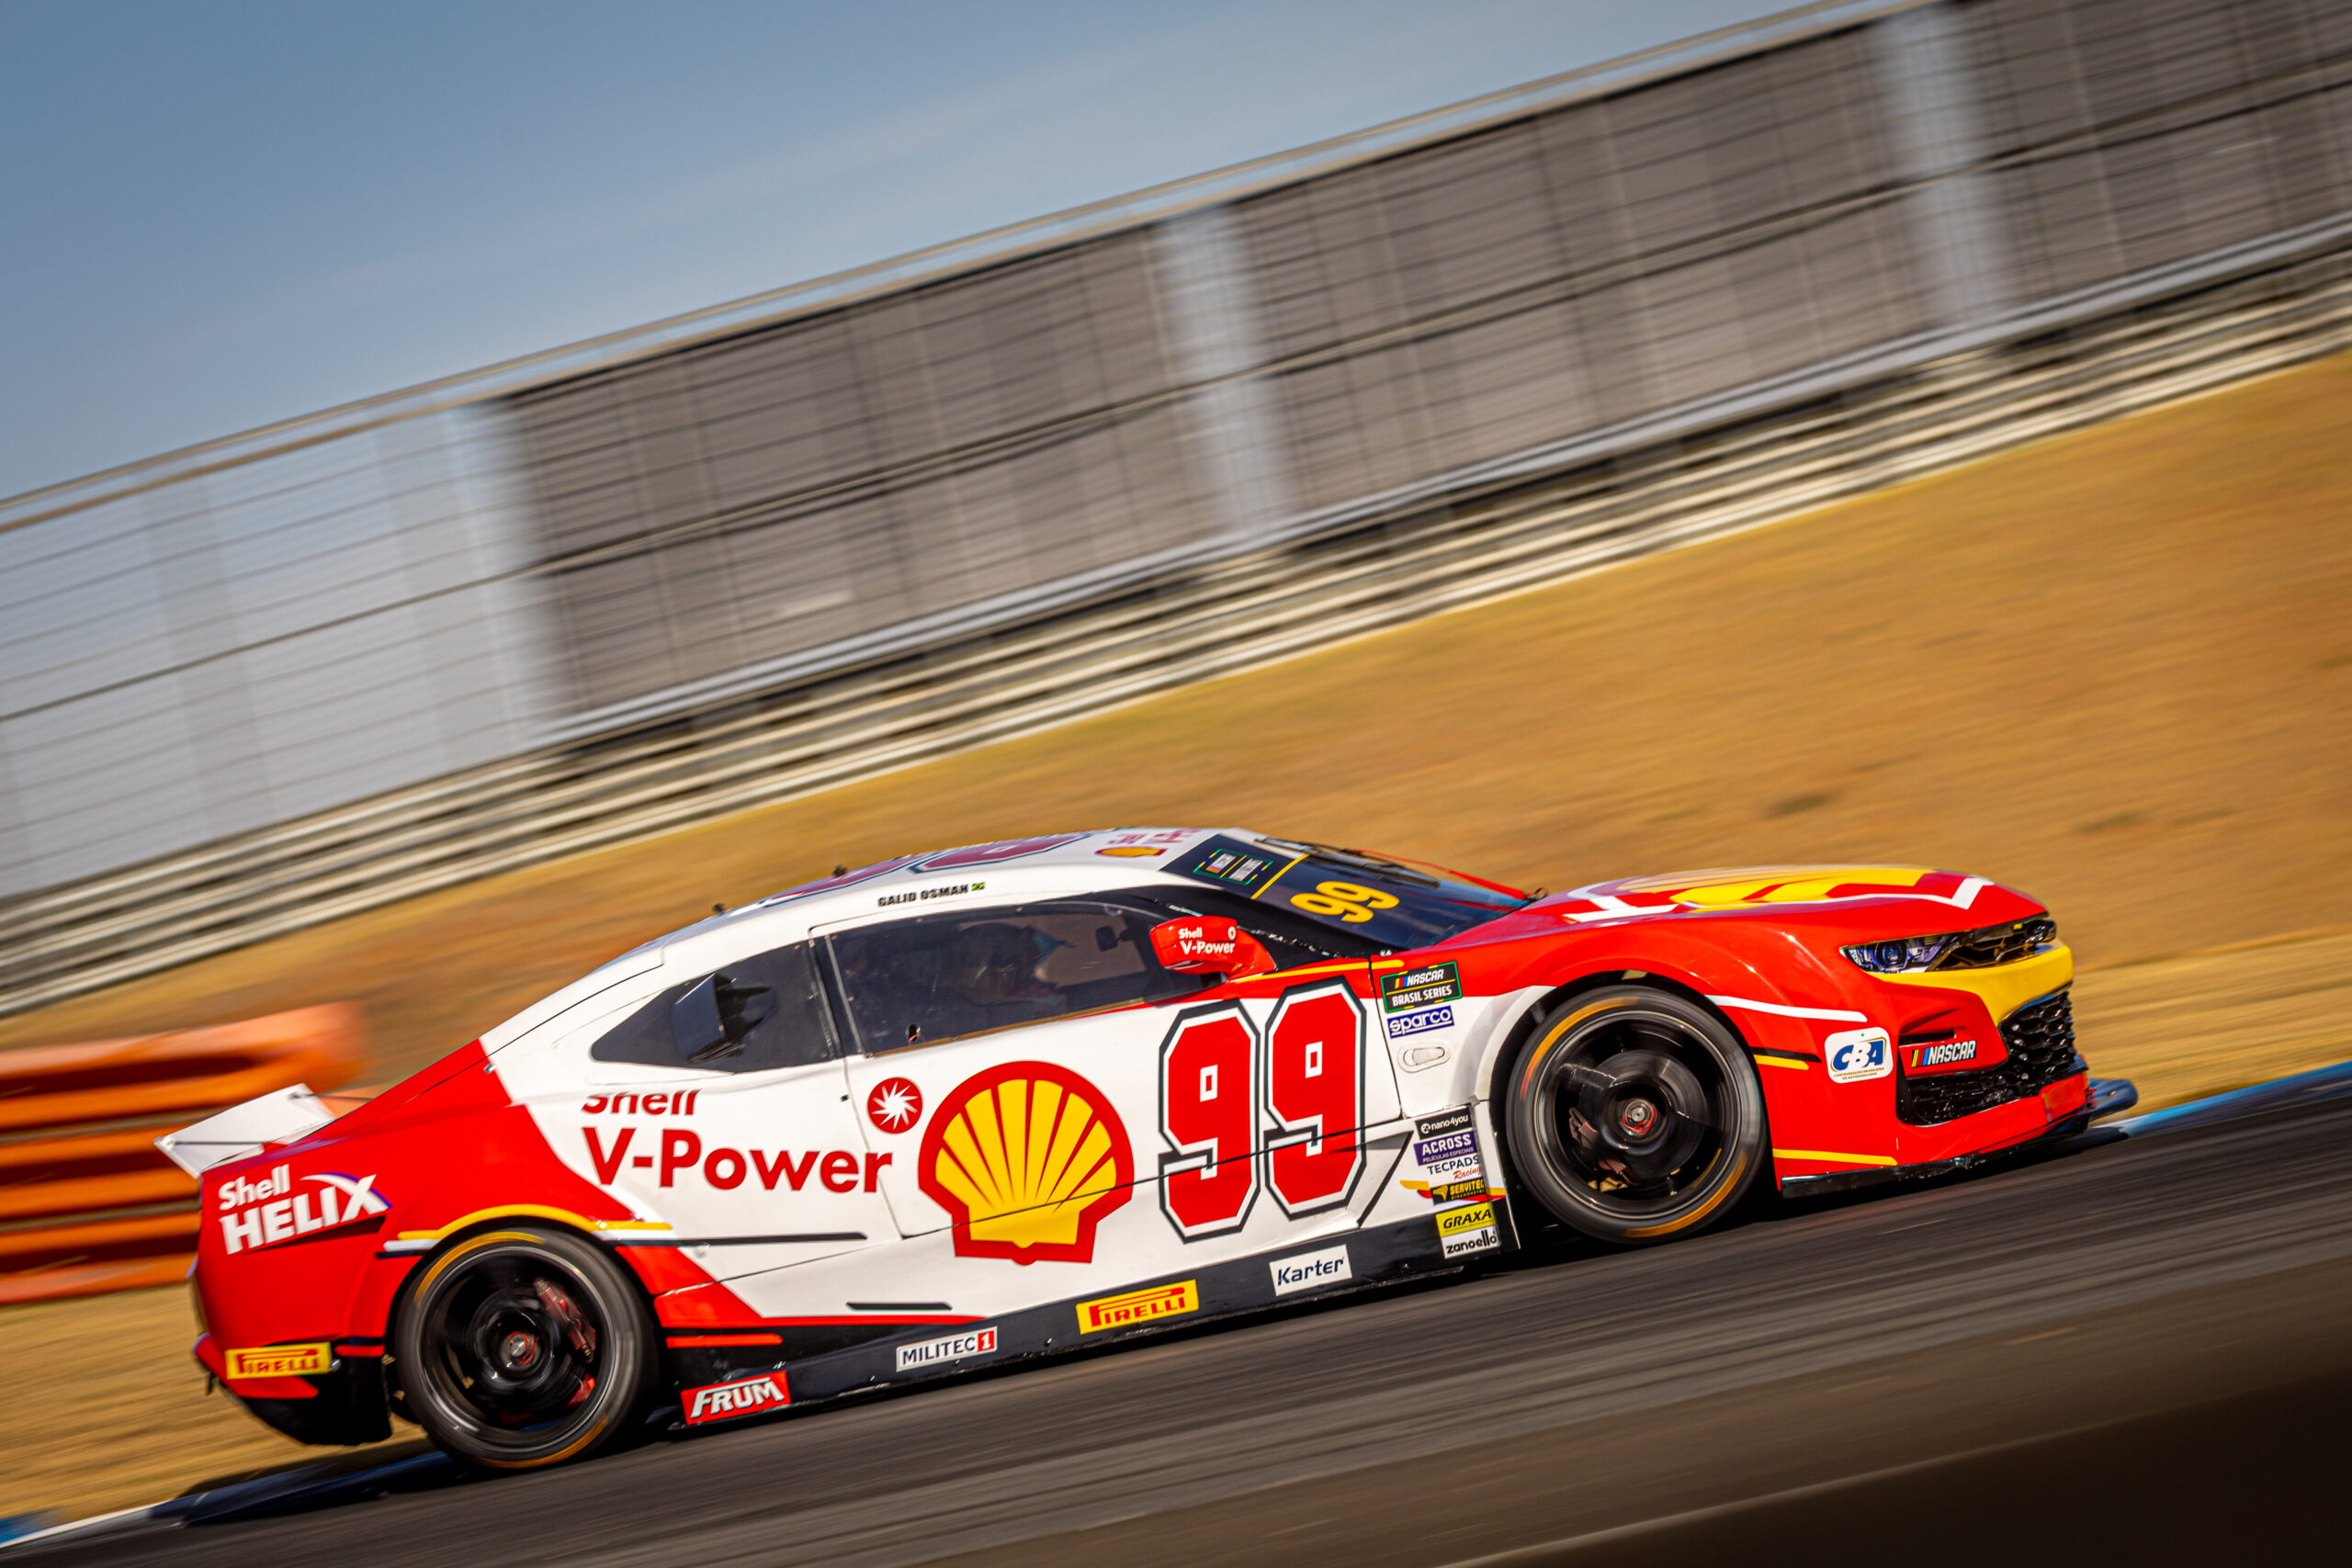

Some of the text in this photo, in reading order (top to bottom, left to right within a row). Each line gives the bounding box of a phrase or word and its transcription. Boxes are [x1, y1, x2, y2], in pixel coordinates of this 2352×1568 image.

[1290, 880, 1400, 923] 99
[1178, 927, 1203, 940] Shell
[1180, 941, 1235, 954] V-Power
[1407, 969, 1444, 987] NASCAR
[1392, 985, 1453, 1007] BRASIL SERIES
[1389, 1009, 1452, 1035] sparco
[1833, 1040, 1884, 1071] CBA
[1927, 1040, 1977, 1066] NASCAR
[1158, 975, 1367, 1245] 99
[1430, 1114, 1469, 1131] nano4you
[1422, 1134, 1472, 1156] ACROSS
[581, 1126, 893, 1193] V-Power
[1427, 1155, 1480, 1175] TECPADS
[218, 1163, 291, 1211] Shell
[1453, 1167, 1481, 1181] Racing
[218, 1174, 390, 1256] HELIX
[1442, 1209, 1492, 1229] GRAXA
[1445, 1229, 1497, 1254] zanoello
[1277, 1257, 1346, 1285] Karter
[1089, 1286, 1186, 1327] PIRELLI
[236, 1348, 319, 1374] PIRELLI
[690, 1377, 785, 1418] FRUM
